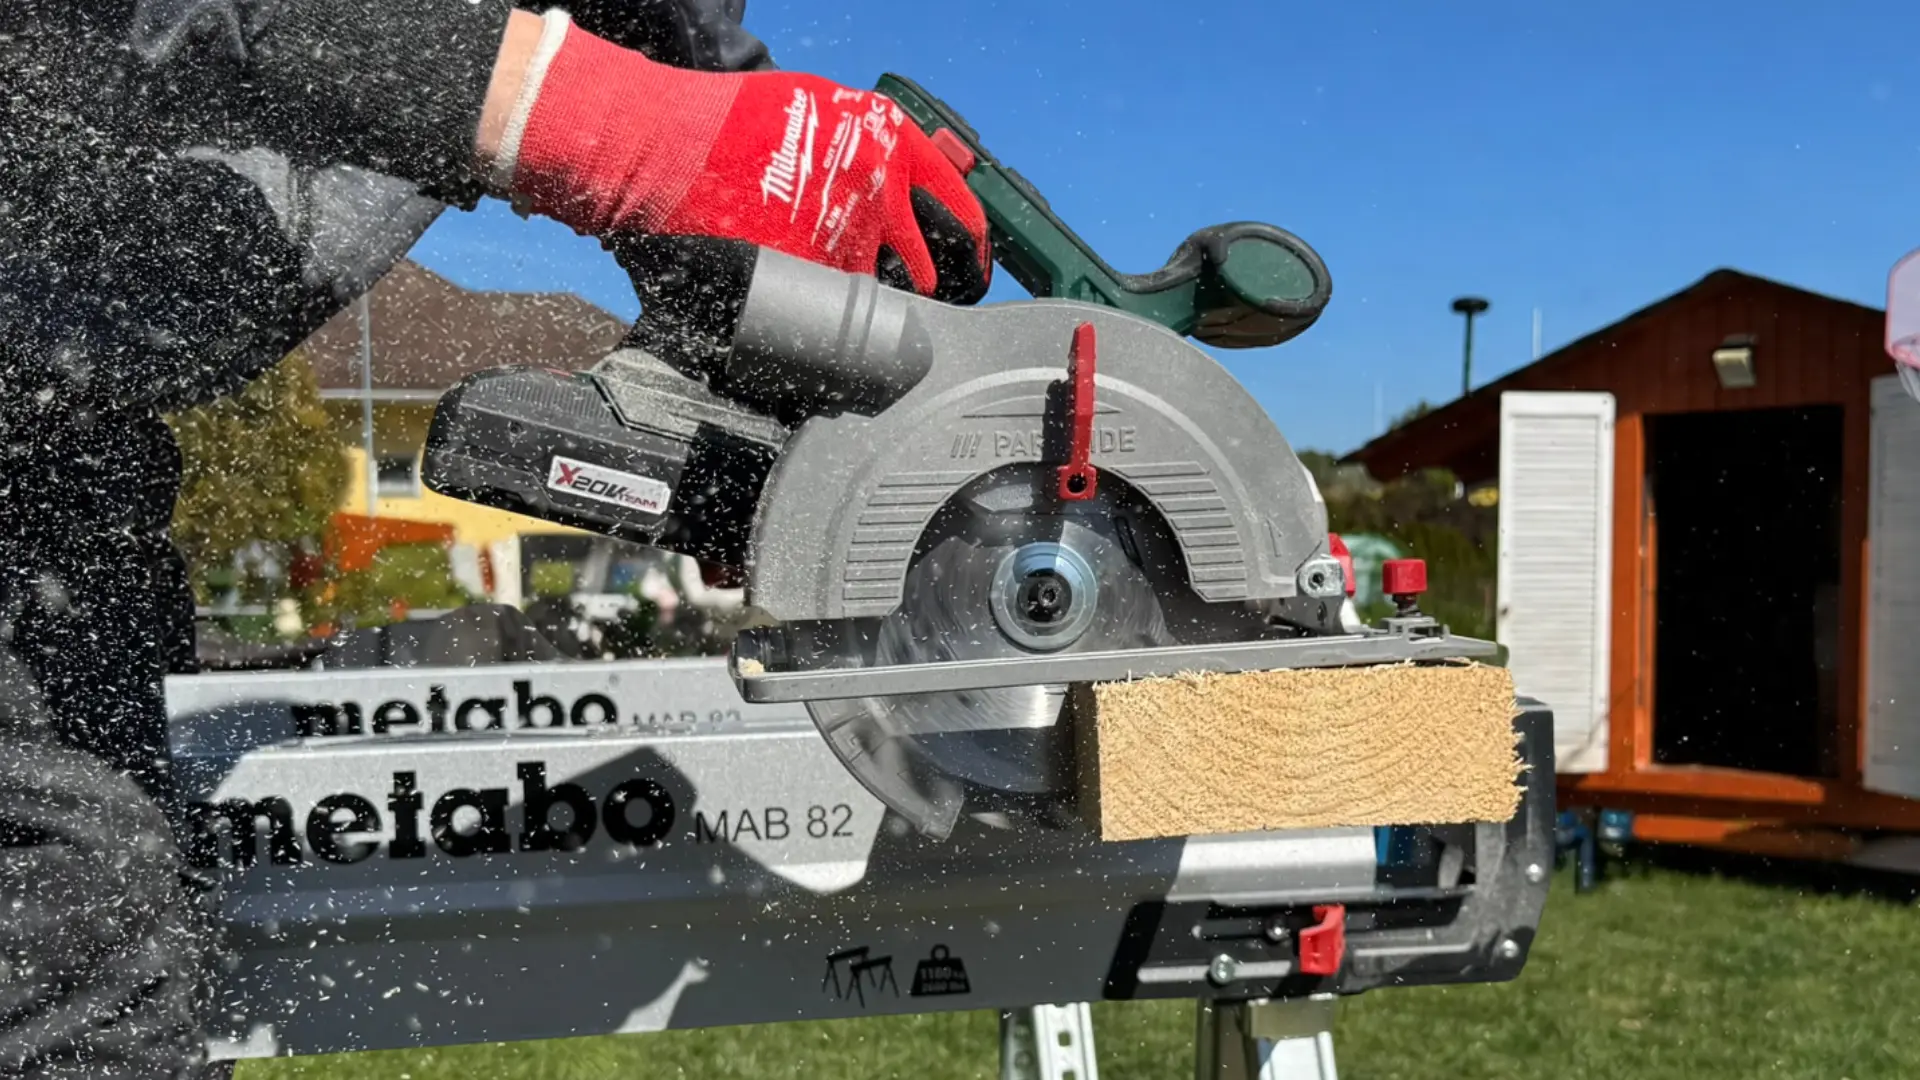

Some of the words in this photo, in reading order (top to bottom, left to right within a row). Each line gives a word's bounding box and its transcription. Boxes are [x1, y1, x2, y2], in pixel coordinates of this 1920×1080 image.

[760, 87, 808, 205] Milwaukee
[993, 425, 1137, 458] PARIDE
[290, 679, 619, 737] metabo
[183, 761, 677, 867] metabo
[694, 806, 790, 844] MAB
[806, 803, 855, 840] 82
